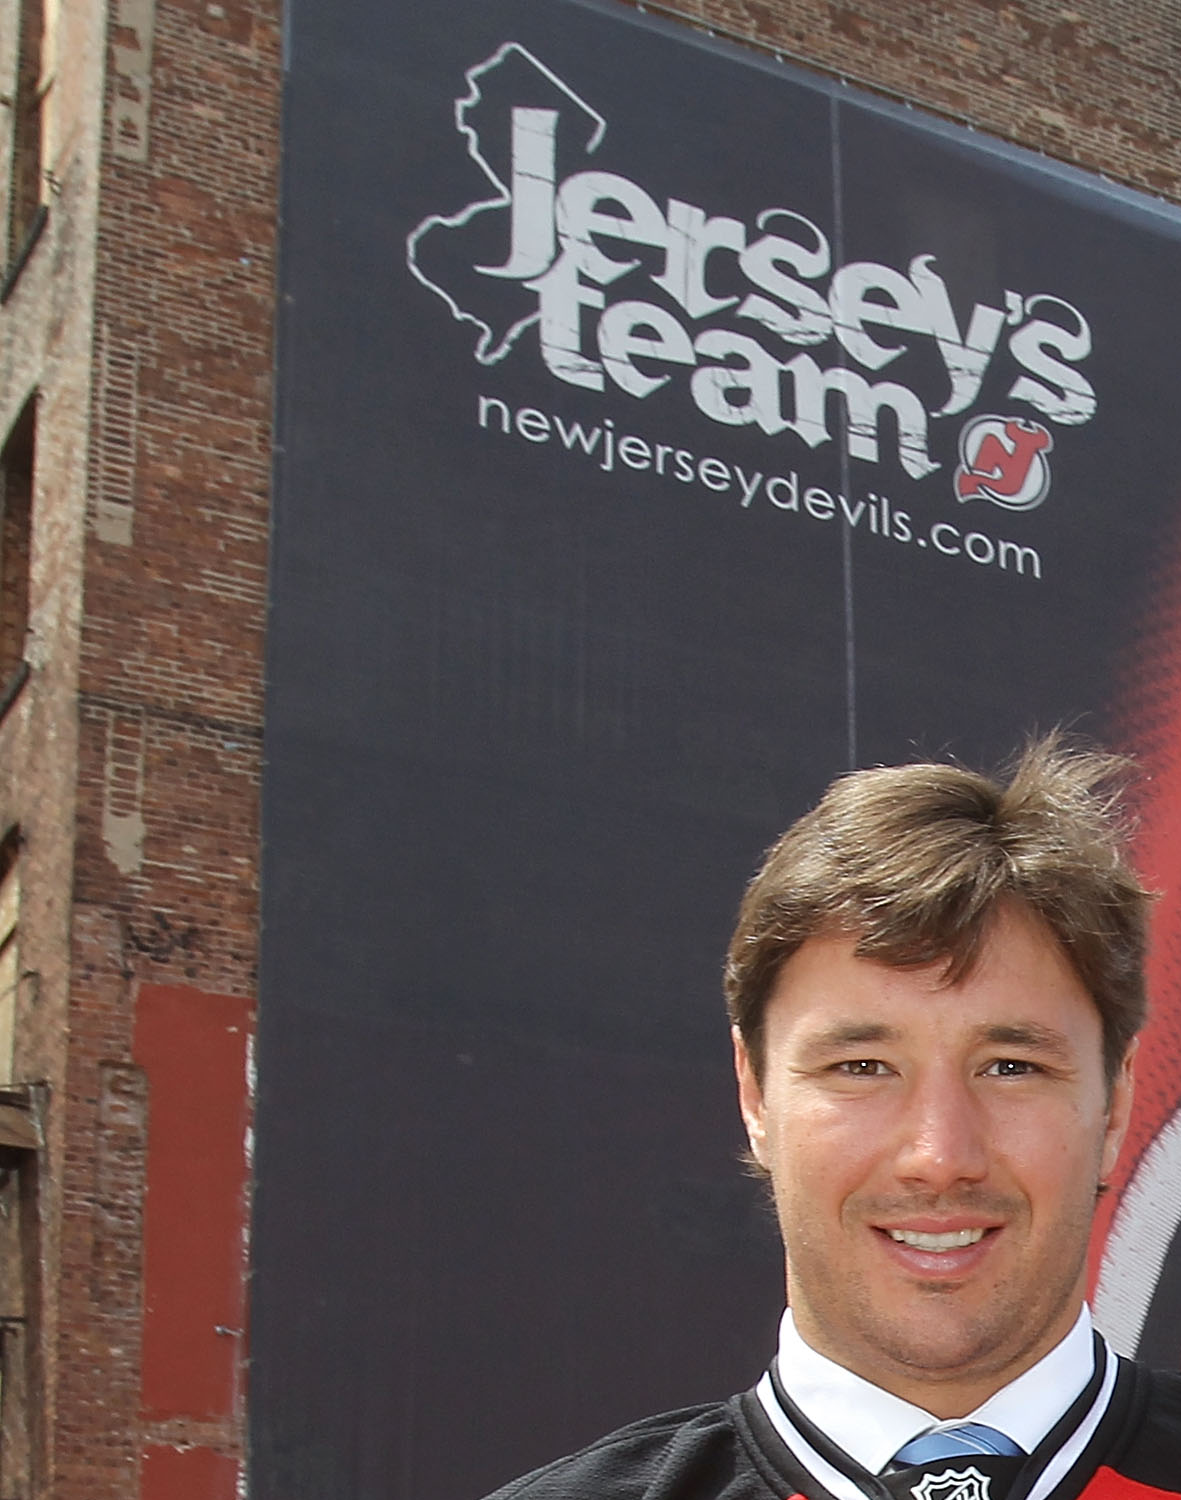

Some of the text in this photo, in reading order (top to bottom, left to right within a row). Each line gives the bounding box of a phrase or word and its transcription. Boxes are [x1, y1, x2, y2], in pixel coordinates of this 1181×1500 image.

[475, 107, 1098, 426] Jersey's
[523, 250, 942, 481] team
[477, 394, 1042, 579] newjerseydevils.com
